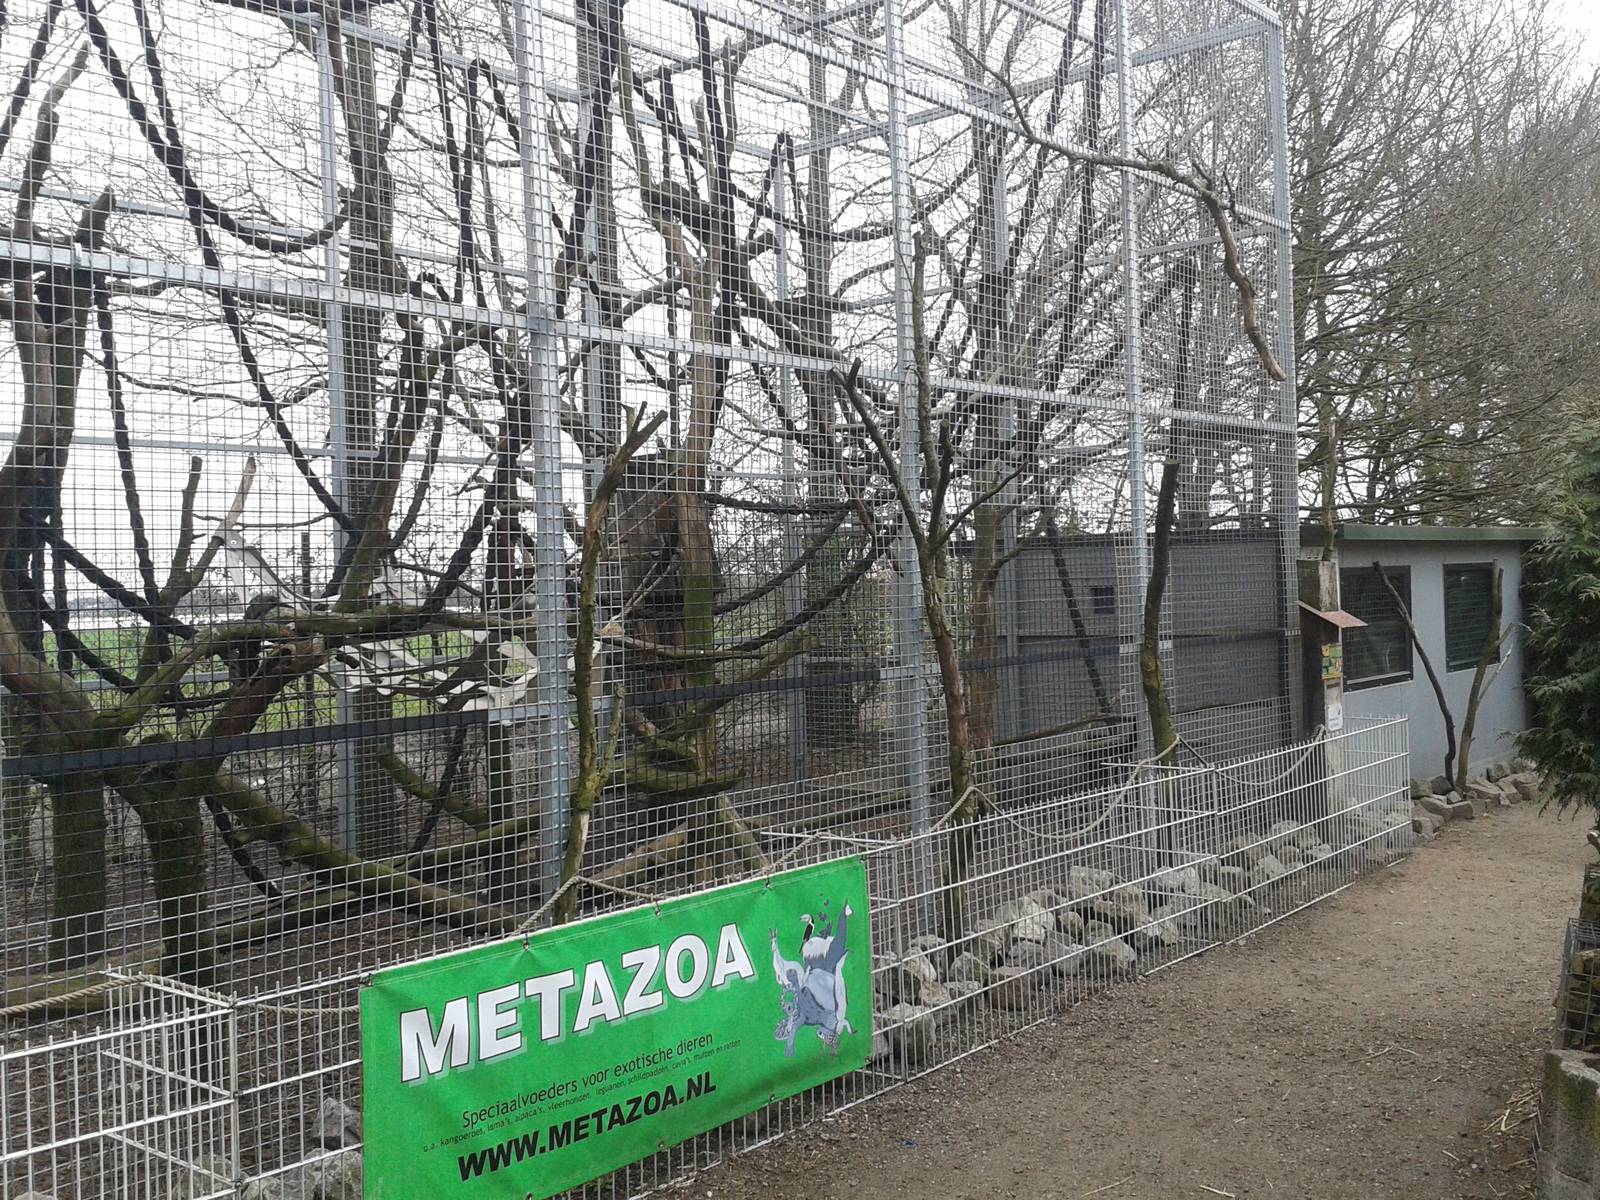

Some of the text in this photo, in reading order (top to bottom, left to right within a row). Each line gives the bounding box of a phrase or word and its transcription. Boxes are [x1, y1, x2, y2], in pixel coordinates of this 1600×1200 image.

[401, 923, 754, 1082] METAZOA
[457, 1071, 717, 1182] WWW.METAZOA.NL
[462, 1033, 713, 1129] Speciaalvoeders voor exotische dieren
